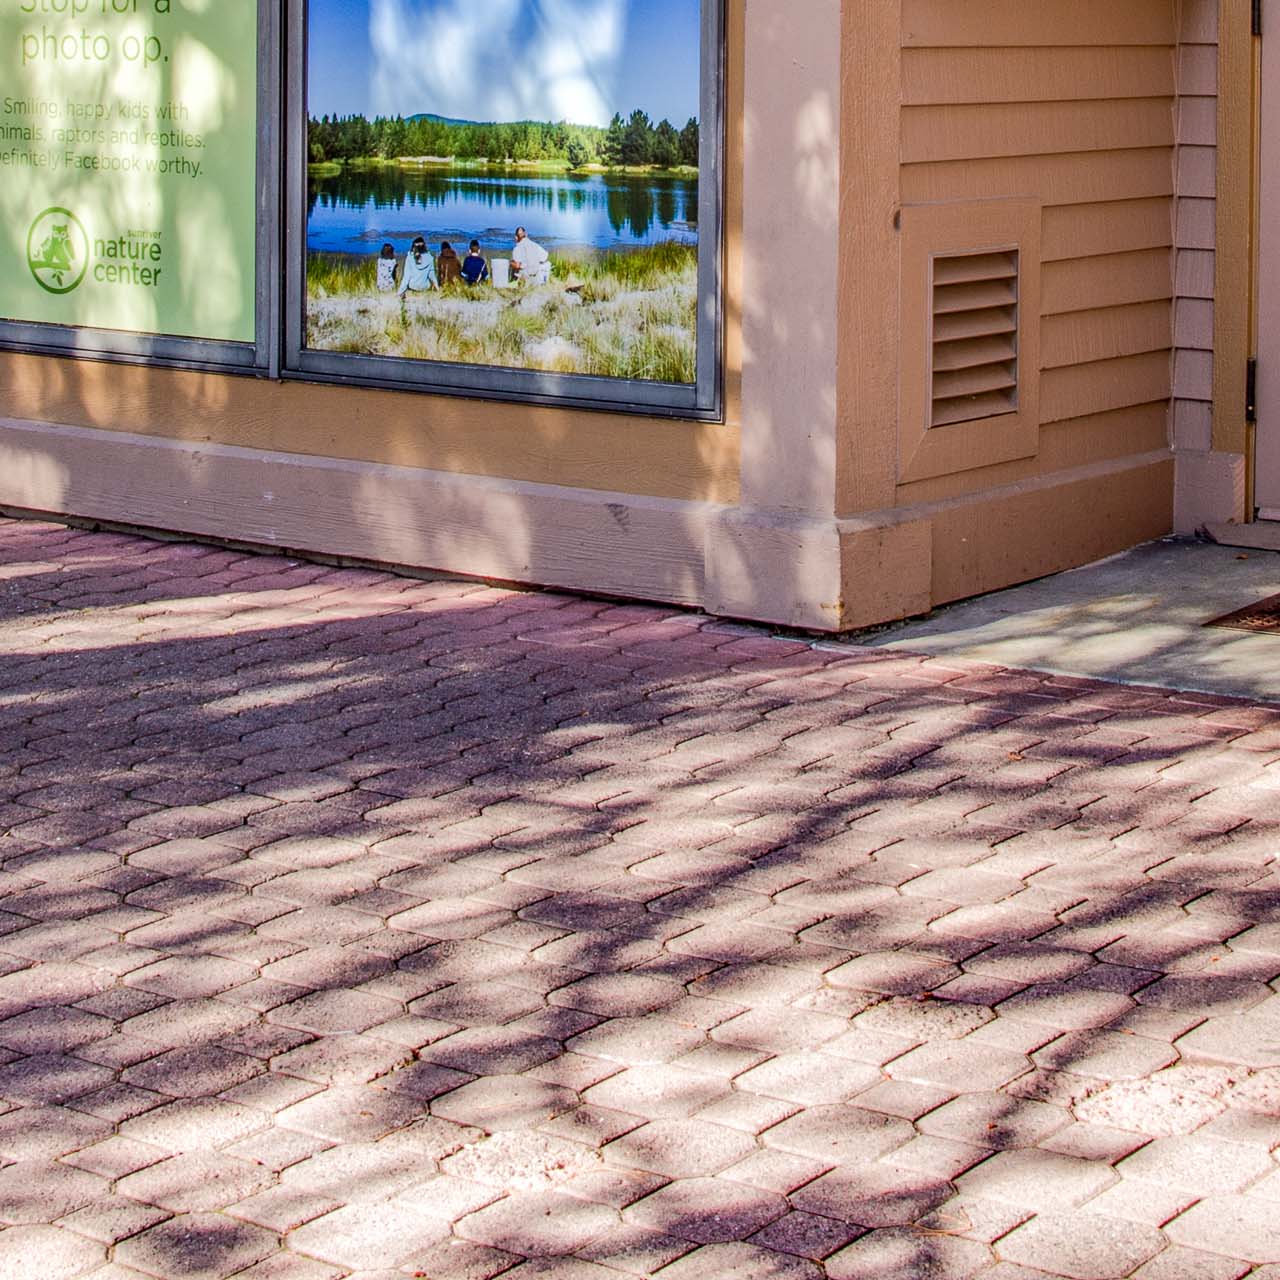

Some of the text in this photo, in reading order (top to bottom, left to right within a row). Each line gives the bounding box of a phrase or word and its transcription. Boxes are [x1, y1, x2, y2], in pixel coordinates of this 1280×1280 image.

[22, 26, 168, 68] photo op.
[4, 96, 188, 121] Smiling, happy kids with
[51, 127, 105, 144] raptors
[110, 129, 137, 144] and
[65, 151, 139, 171] Facebook
[145, 156, 203, 178] worthy.
[94, 236, 161, 261] nature
[94, 262, 161, 286] center
